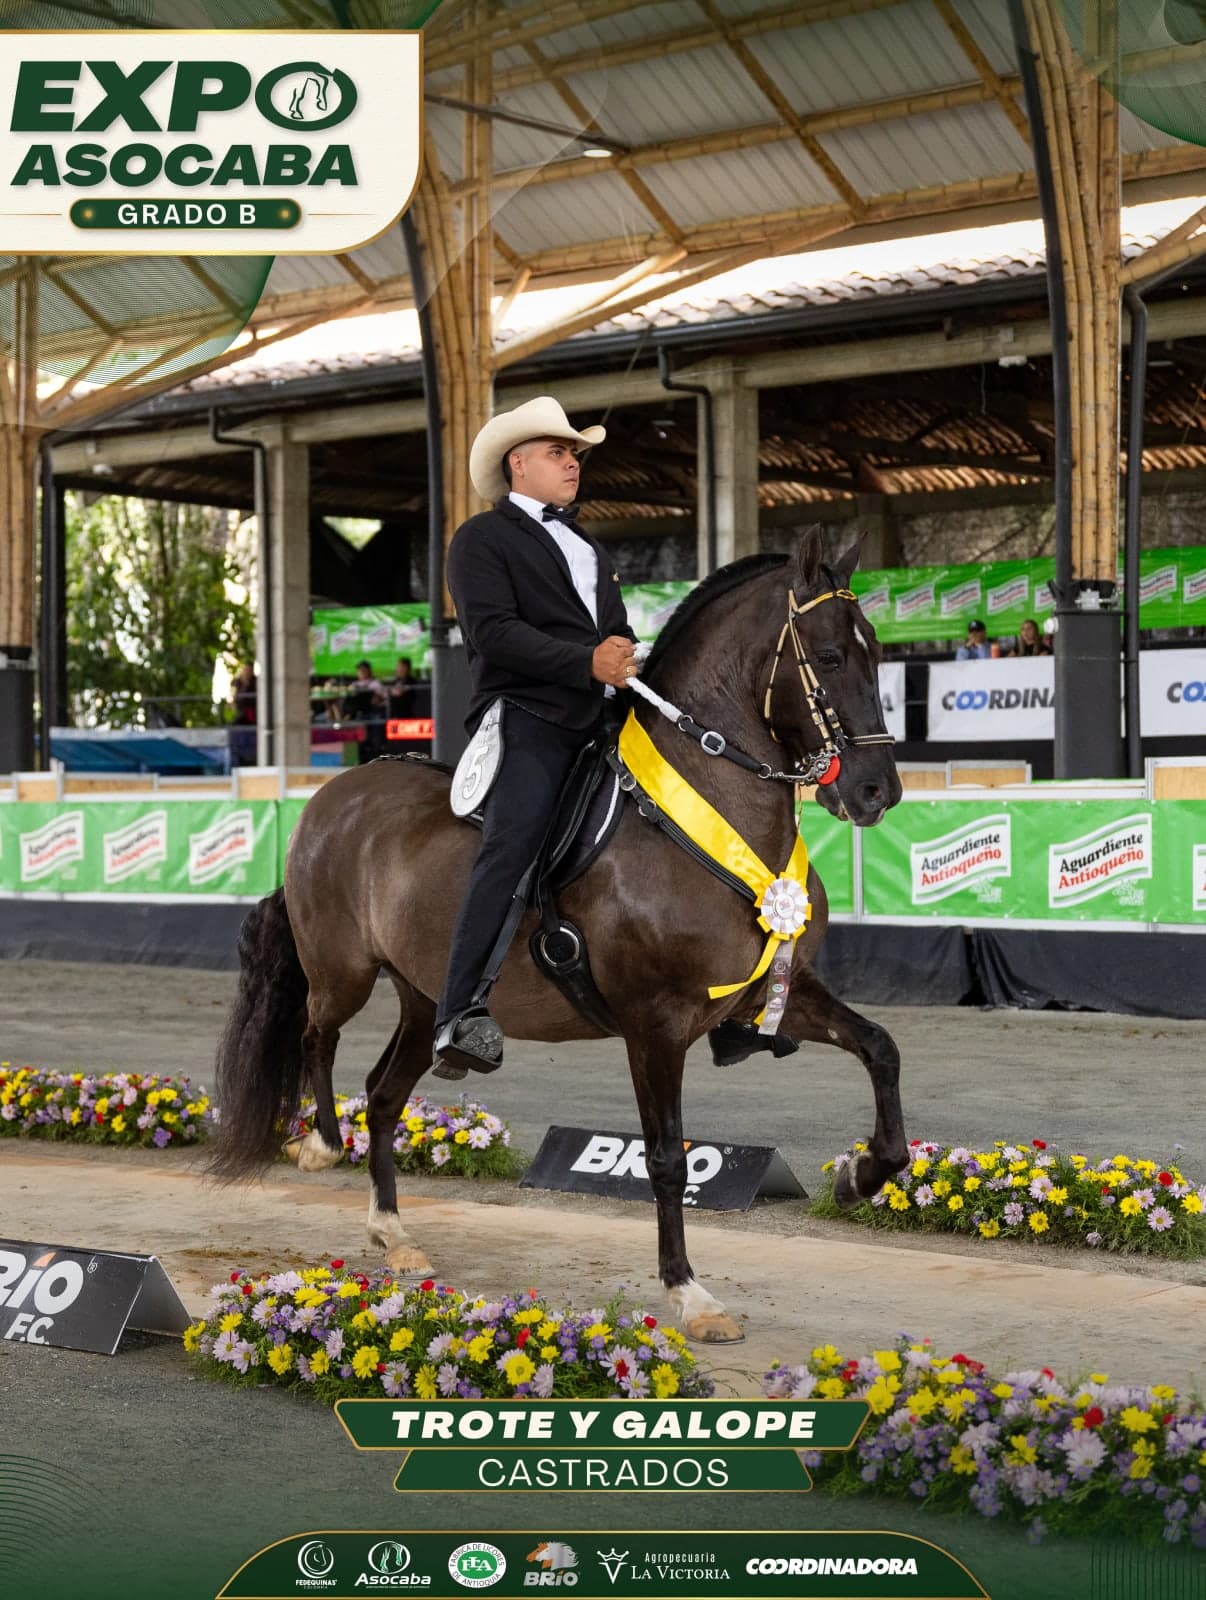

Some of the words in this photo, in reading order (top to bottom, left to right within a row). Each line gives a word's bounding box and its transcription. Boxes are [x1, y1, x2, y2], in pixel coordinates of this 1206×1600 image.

[921, 834, 1001, 871] Aguardiente
[921, 846, 1002, 886] Antioqueño
[1058, 847, 1144, 889] Antioqueño
[1060, 833, 1143, 873] Aguardiente
